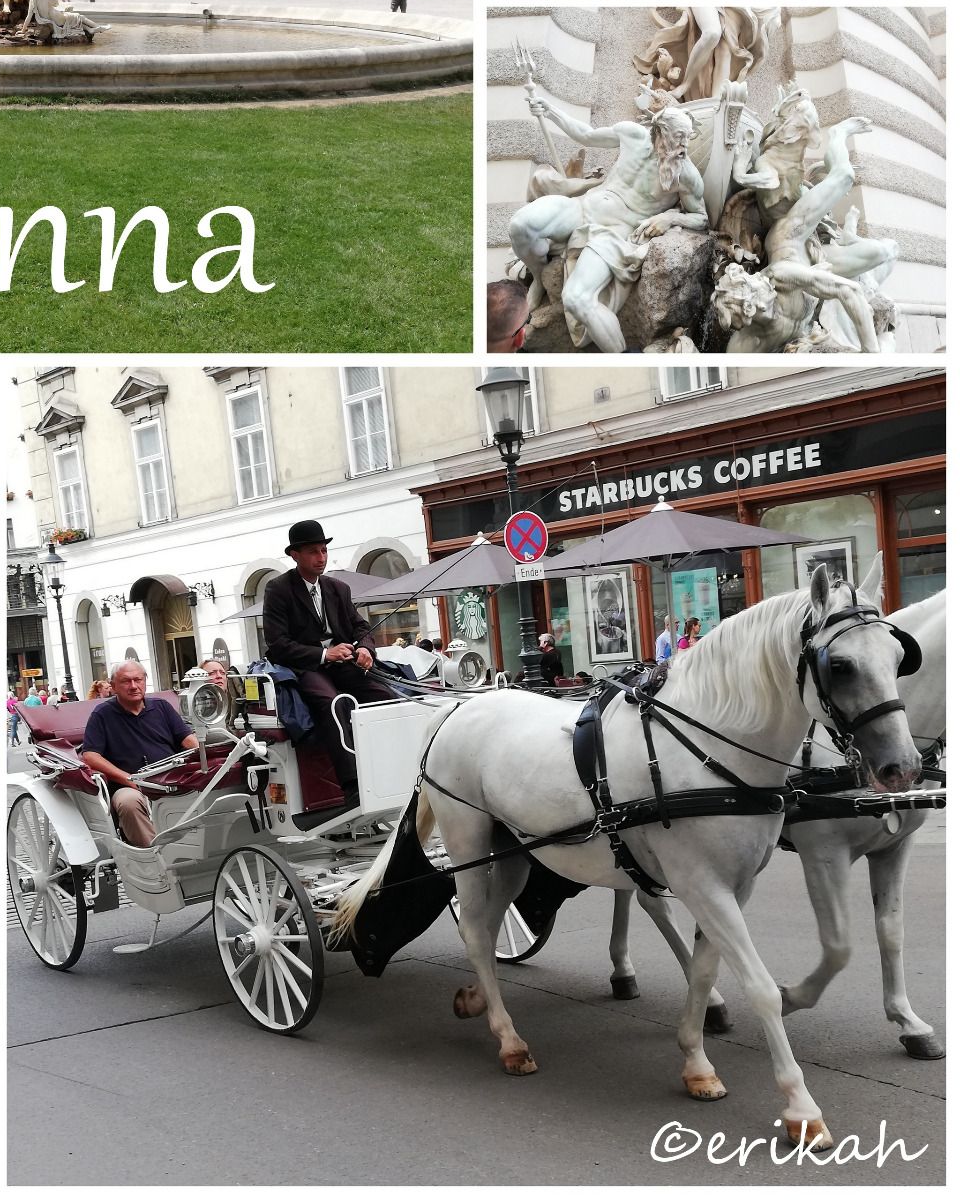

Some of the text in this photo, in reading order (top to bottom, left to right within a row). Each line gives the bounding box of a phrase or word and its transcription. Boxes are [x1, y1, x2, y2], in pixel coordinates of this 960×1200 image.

[559, 441, 822, 514] STARBUCKS COFFEE
[520, 567, 539, 578] Ende
